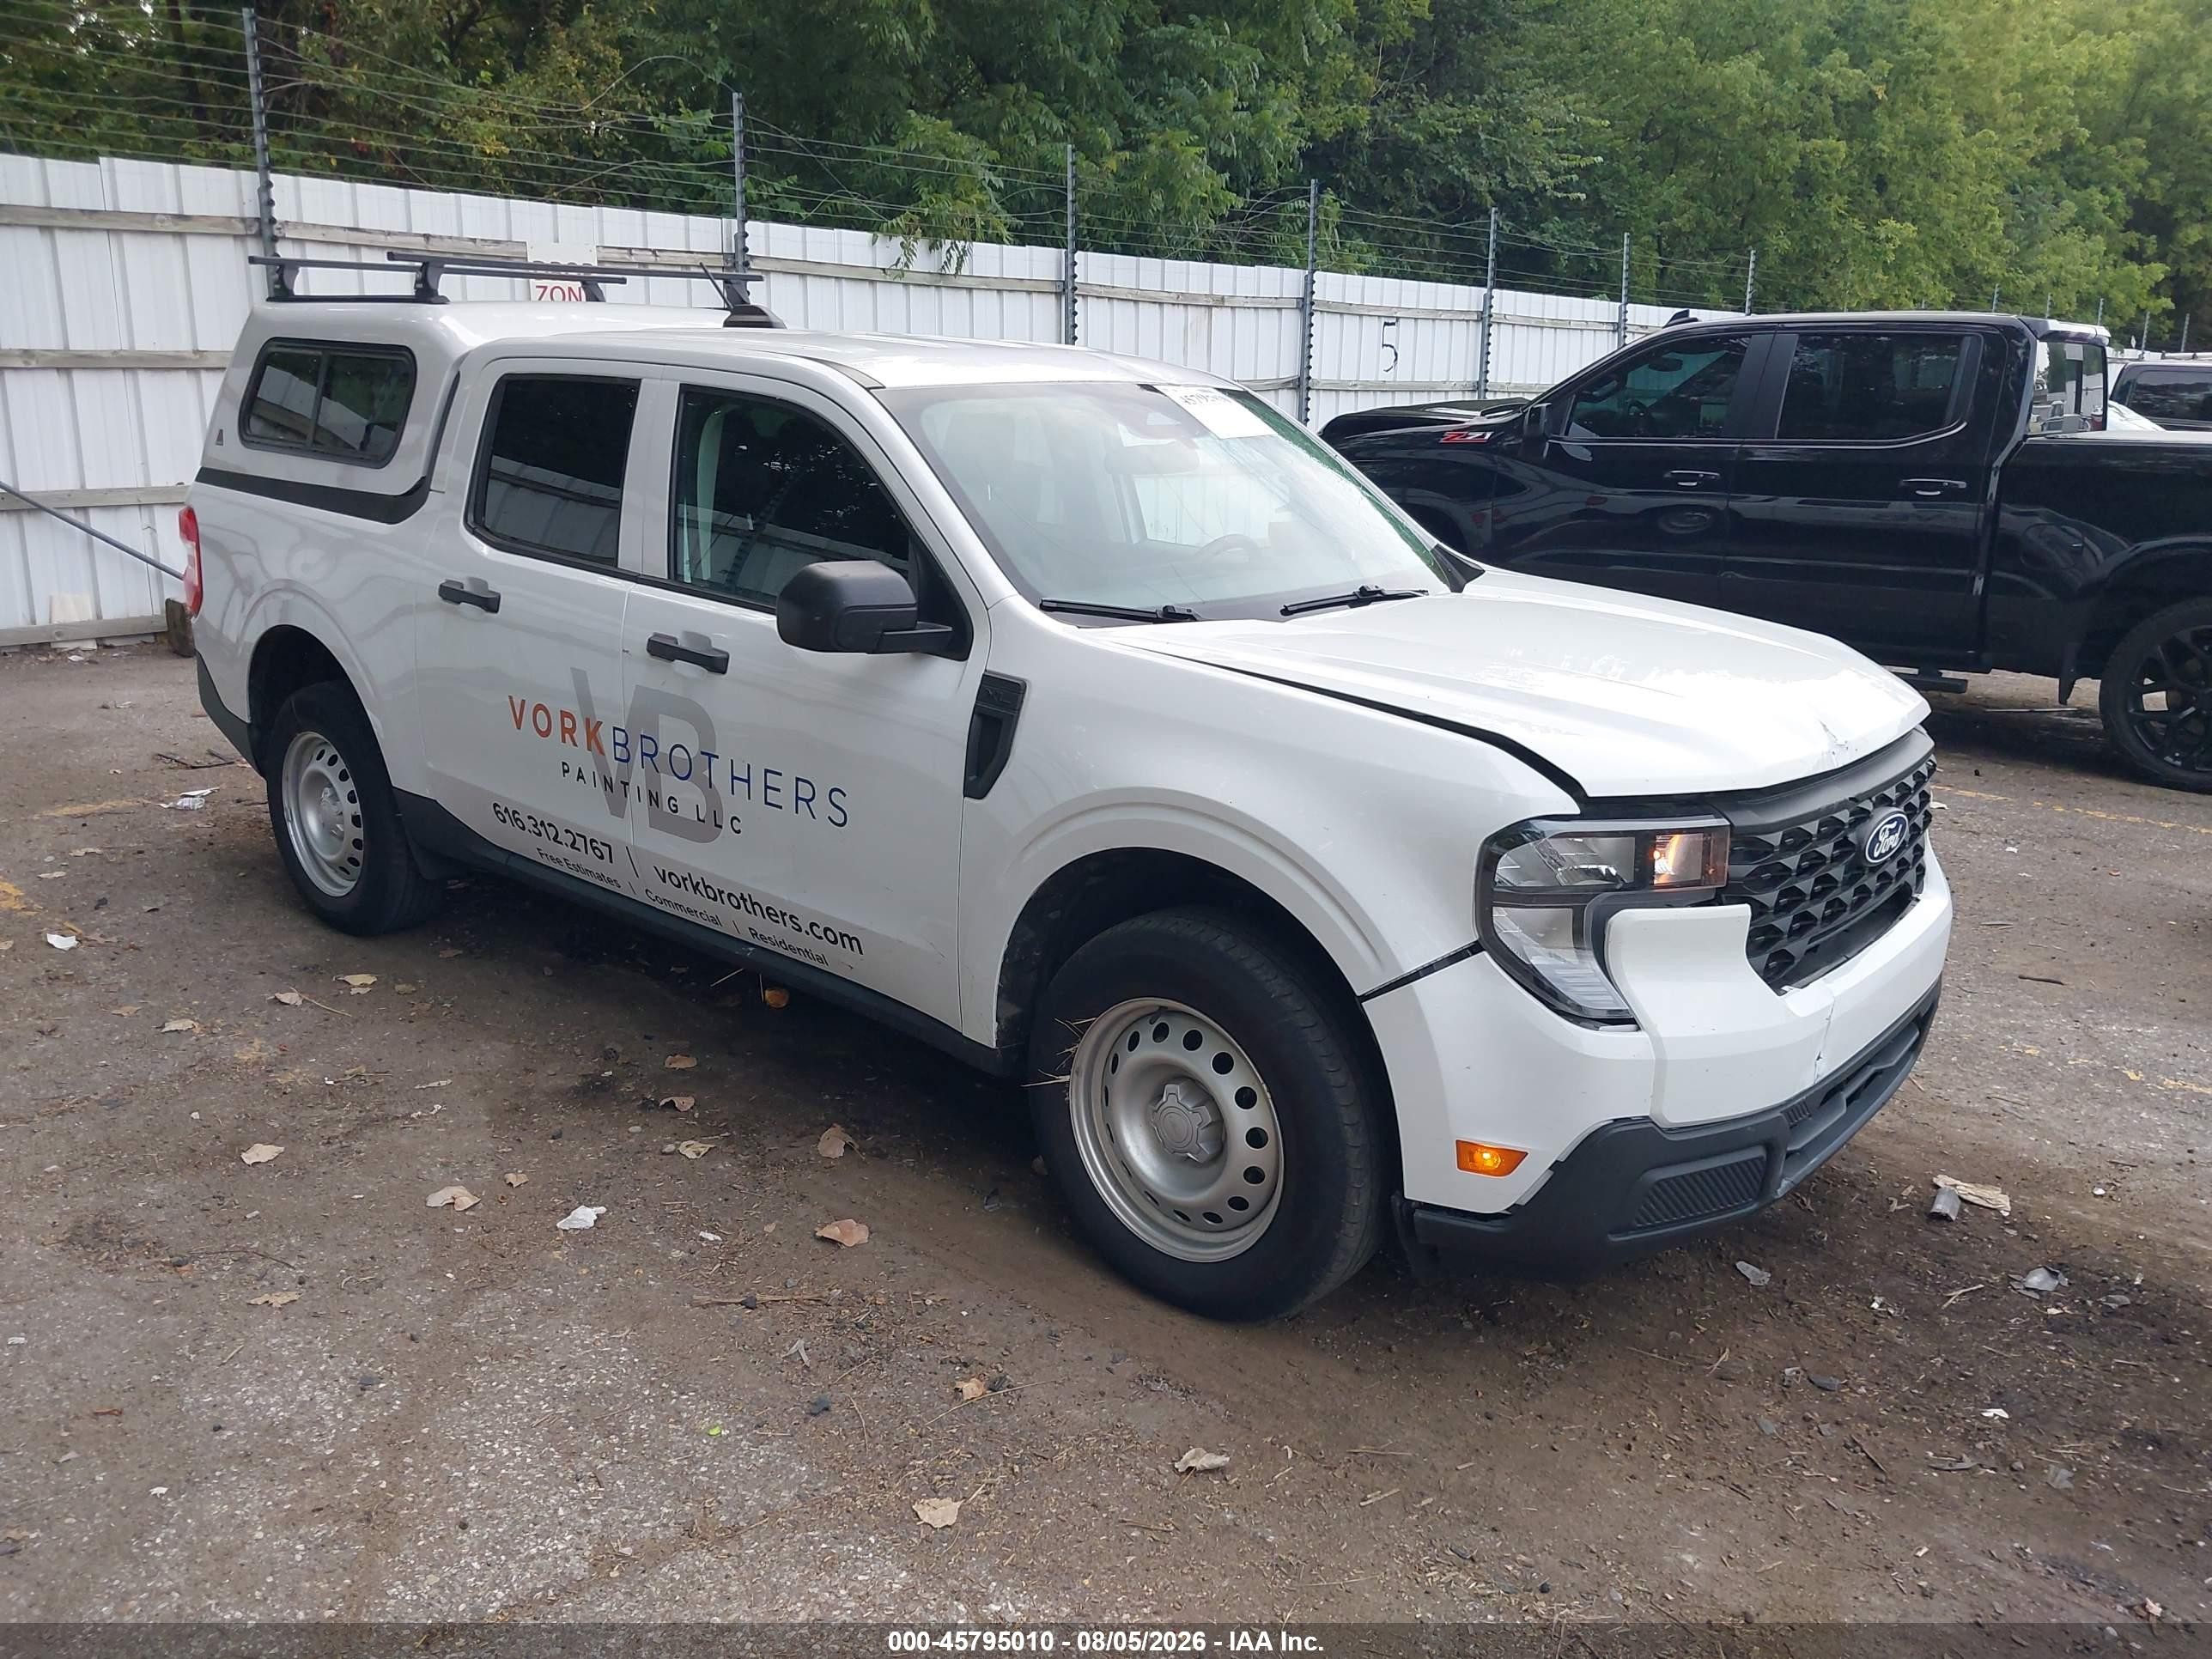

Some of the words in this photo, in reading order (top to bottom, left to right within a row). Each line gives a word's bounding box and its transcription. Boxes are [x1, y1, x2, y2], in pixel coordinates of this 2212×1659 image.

[535, 284, 582, 301] ZON
[1382, 321, 1398, 373] 5
[1439, 430, 1495, 444] Z71
[561, 761, 679, 814] PAINTING
[696, 803, 743, 835] LLC
[493, 802, 614, 864] 616.312.2767
[653, 865, 864, 956] vorkbrothers.com
[536, 847, 563, 866] Free
[563, 857, 622, 890] Estimates
[644, 888, 723, 927] Commercial
[747, 926, 830, 967] Residential
